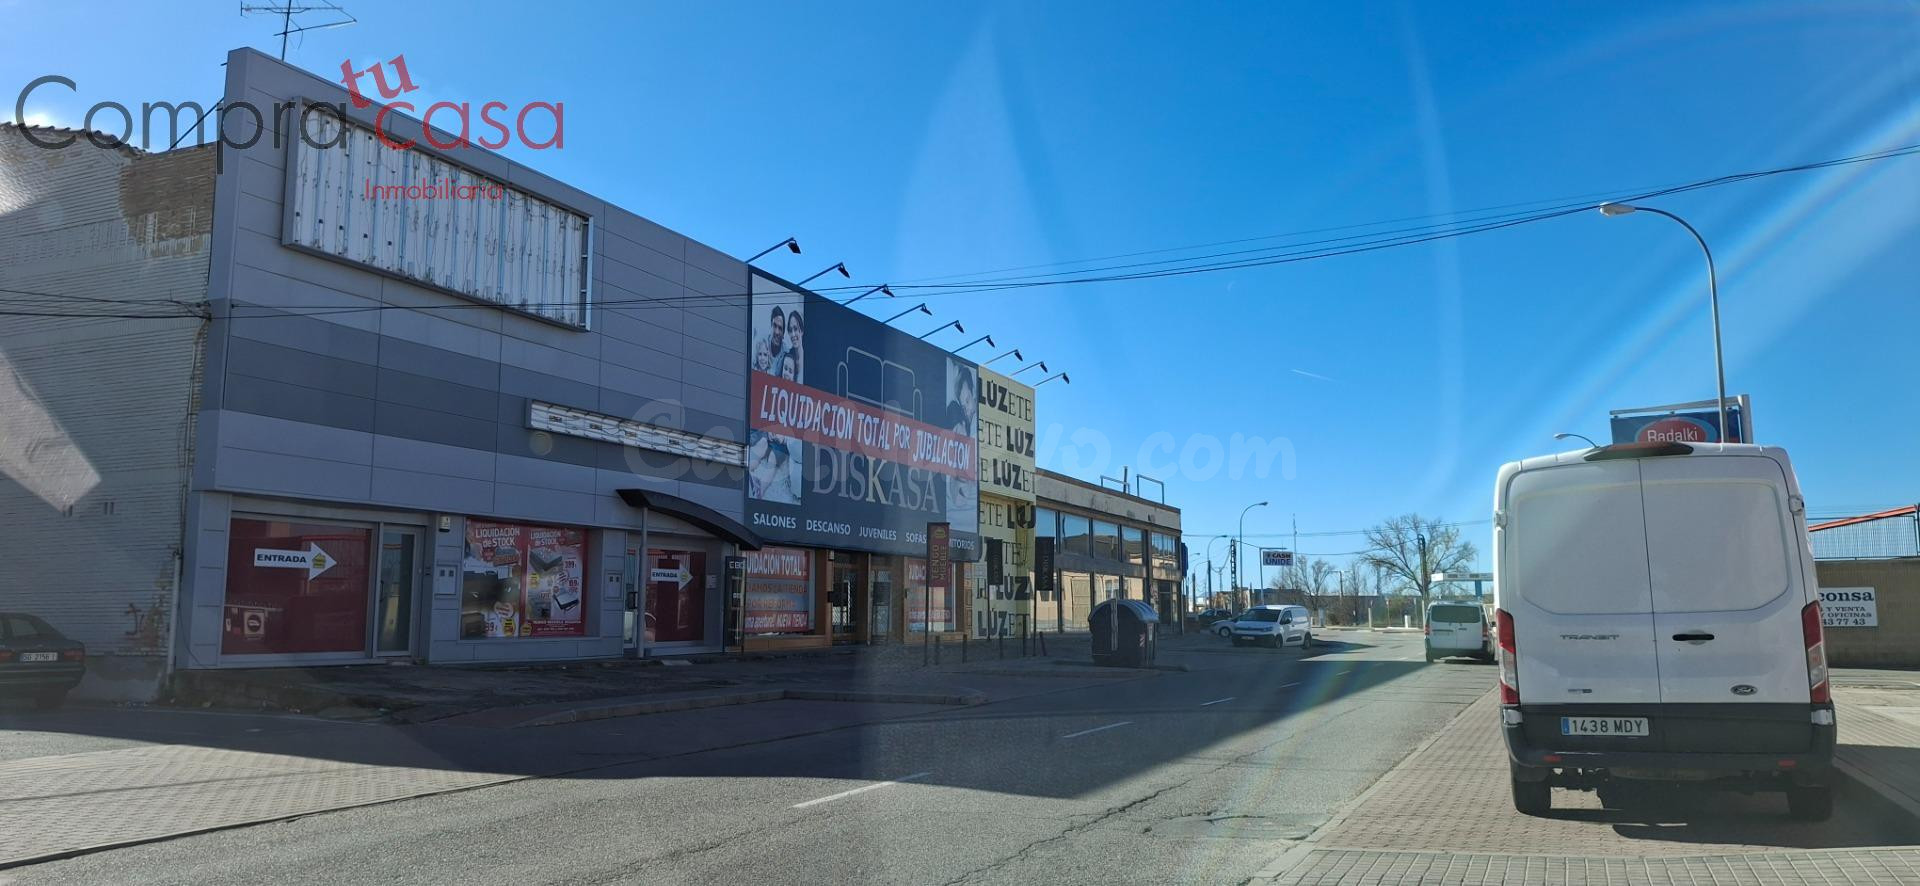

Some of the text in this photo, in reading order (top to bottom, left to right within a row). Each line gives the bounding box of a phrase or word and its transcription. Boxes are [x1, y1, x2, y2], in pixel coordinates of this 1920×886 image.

[760, 384, 970, 470] LIQUIDACION TOTAL POR JUBILACION
[812, 443, 941, 514] DISKASA
[753, 512, 797, 529] SALONES
[806, 519, 851, 536] DESCANSO
[859, 526, 897, 541] JUVENILES
[256, 554, 307, 563] ENTRADA
[747, 553, 780, 575] UIDACION
[1819, 591, 1874, 601] consa
[1572, 719, 1644, 733] 1438 MDY
